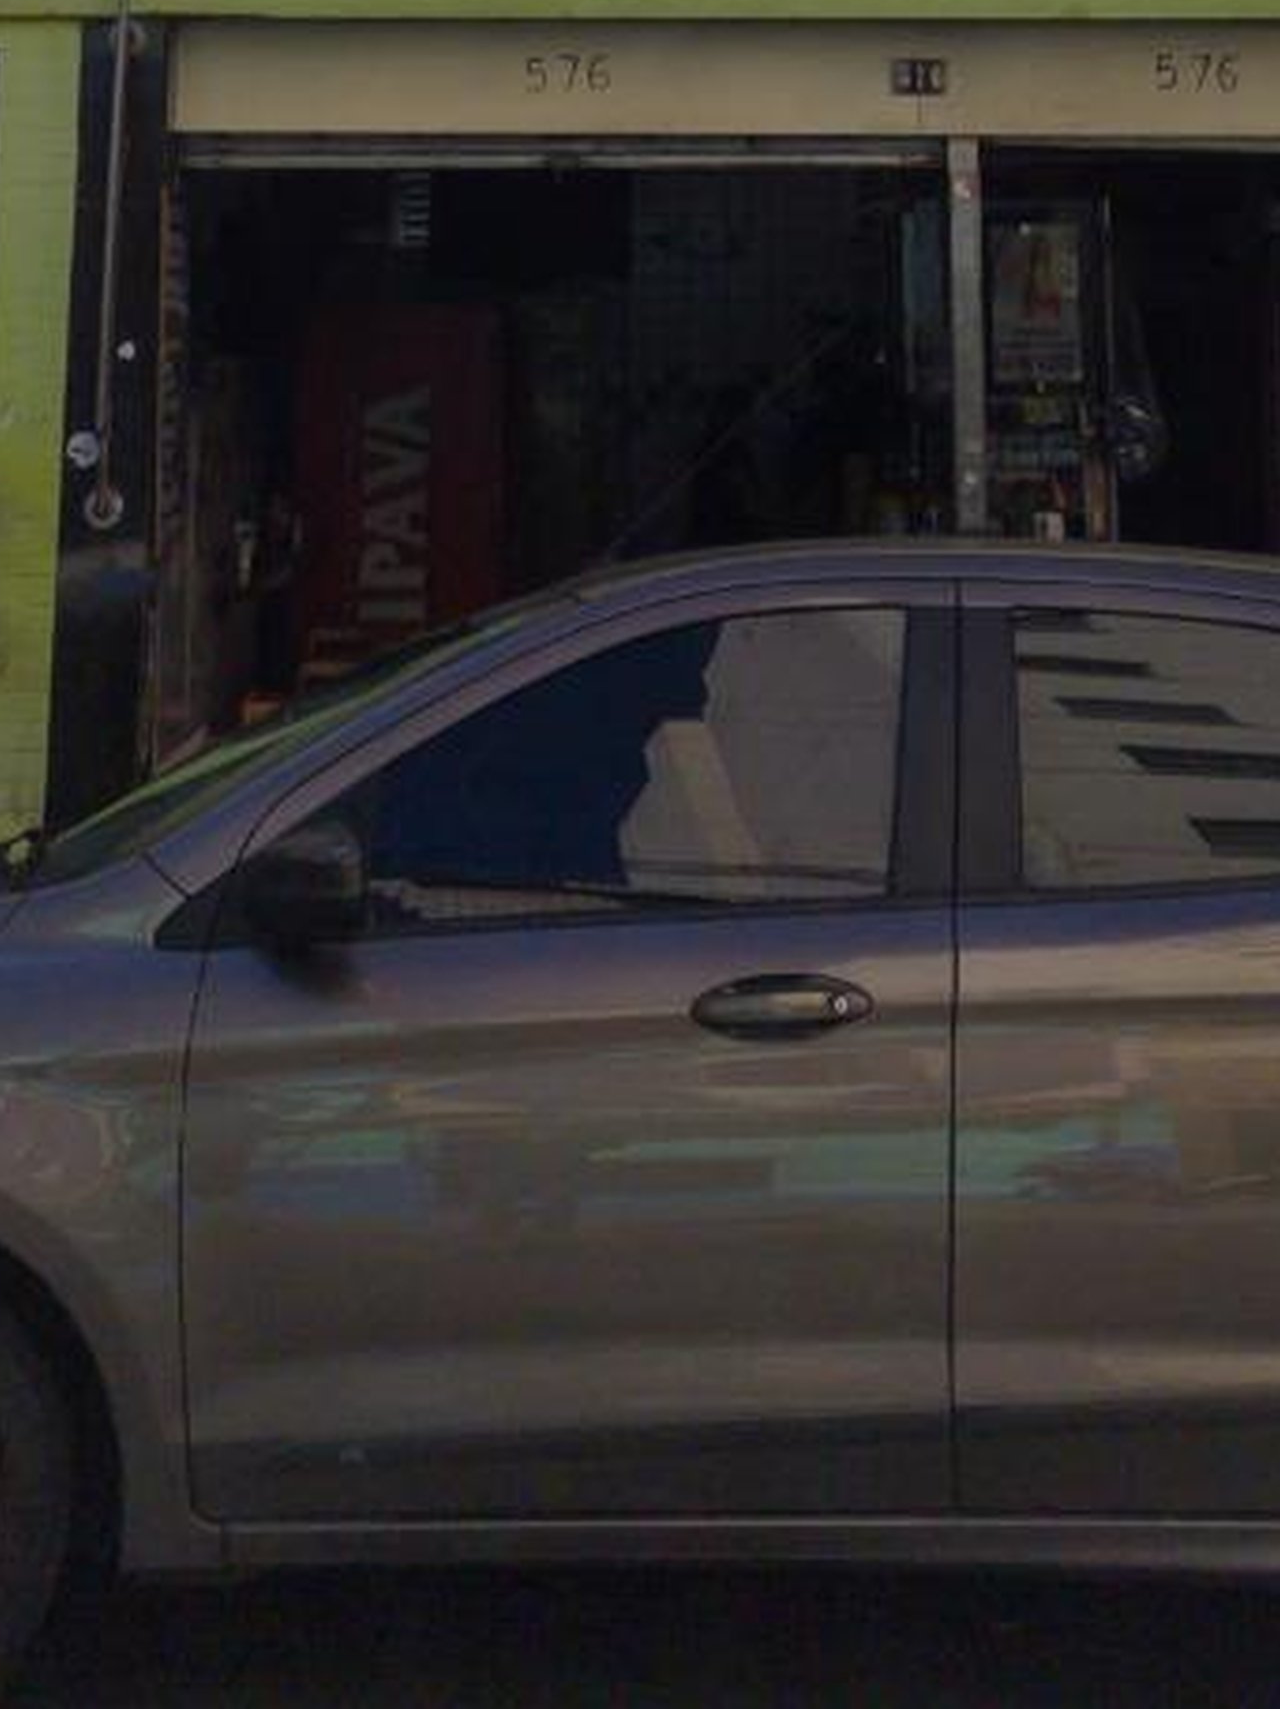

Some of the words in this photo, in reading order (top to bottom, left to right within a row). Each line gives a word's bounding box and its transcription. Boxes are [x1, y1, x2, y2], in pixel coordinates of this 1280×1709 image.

[525, 52, 612, 94] 576
[1155, 53, 1240, 94] 576
[356, 384, 433, 624] IPAVA
